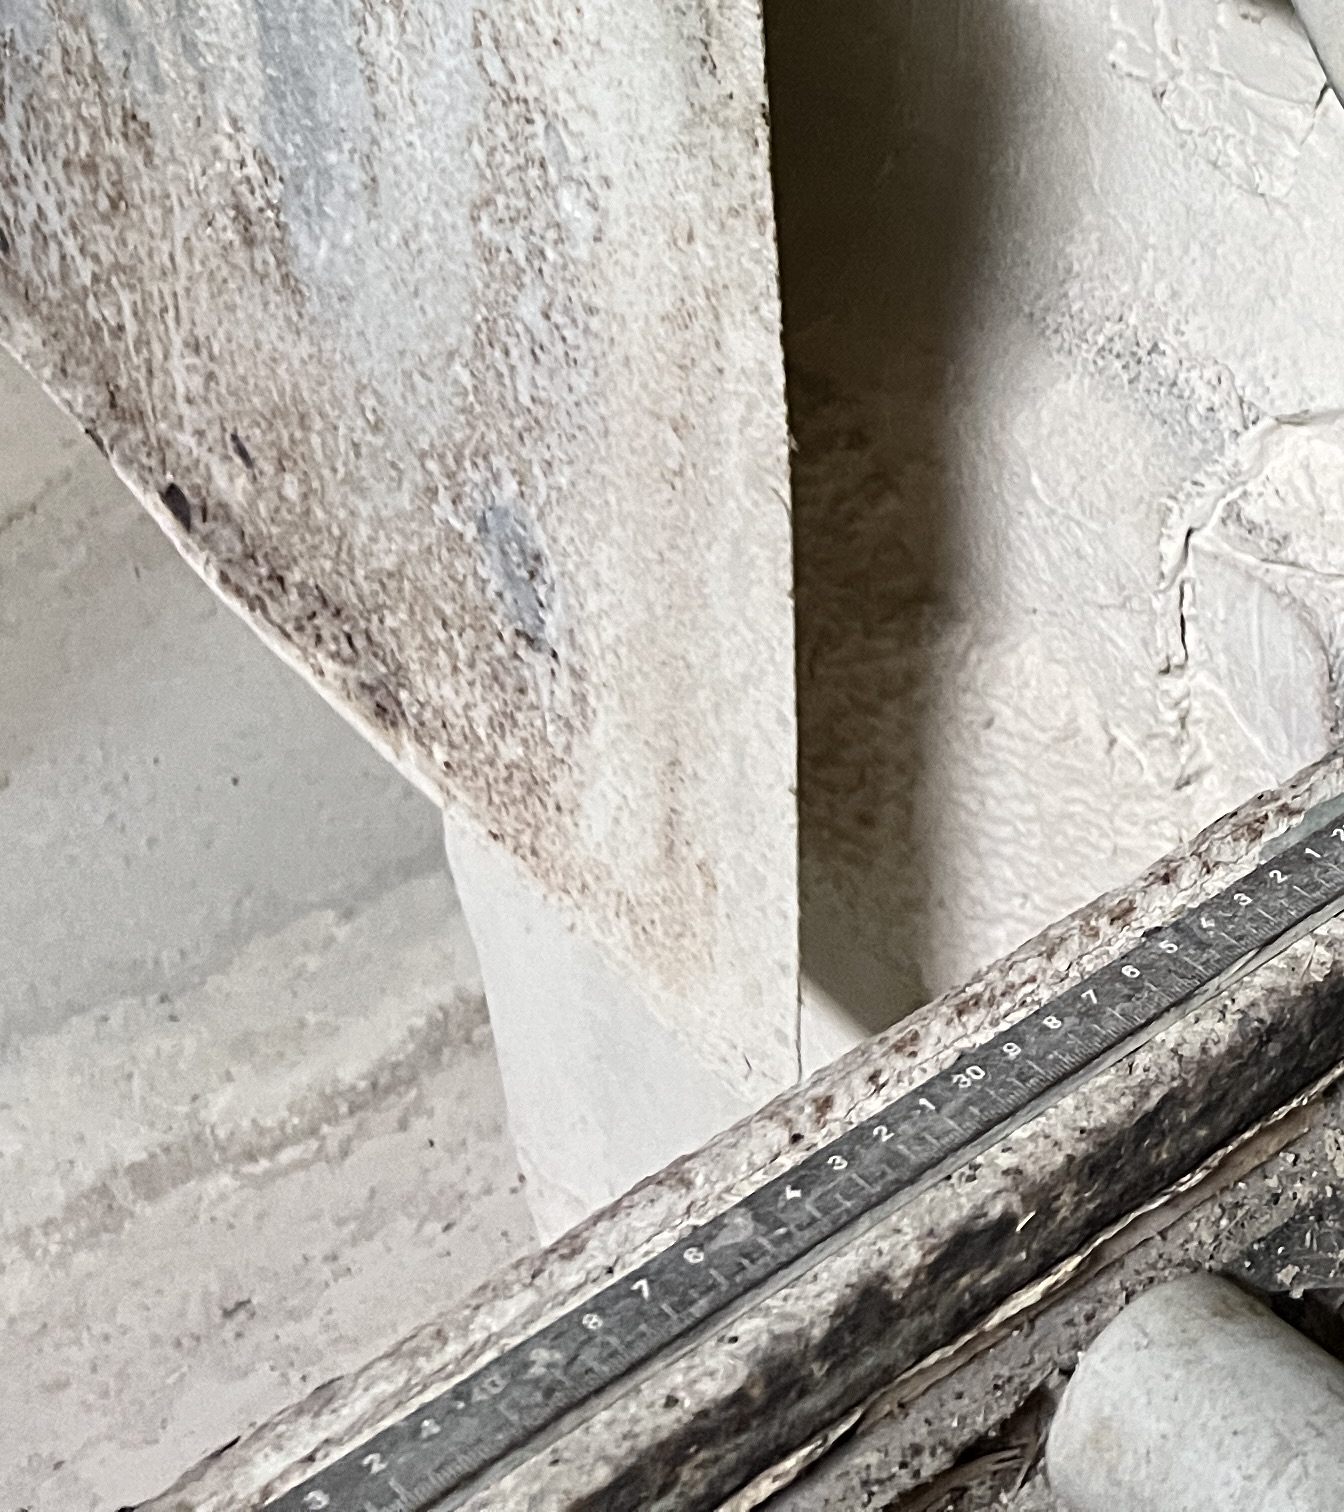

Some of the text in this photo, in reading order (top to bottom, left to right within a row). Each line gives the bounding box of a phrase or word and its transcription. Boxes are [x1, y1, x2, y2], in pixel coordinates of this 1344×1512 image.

[363, 1453, 388, 1475] 2
[582, 1313, 603, 1330] 8
[631, 1279, 649, 1300] 7
[828, 1156, 848, 1170] 3
[873, 1126, 895, 1142] 2
[919, 1098, 936, 1110] 1
[953, 1065, 986, 1088] 30
[1003, 1043, 1021, 1057] 9
[1043, 1016, 1062, 1029] 8
[1081, 989, 1098, 1004] 7
[1121, 965, 1140, 978] 6
[1159, 940, 1178, 953] 5
[1233, 893, 1252, 906] 3
[1269, 869, 1288, 884] 2
[1305, 847, 1321, 858] 1
